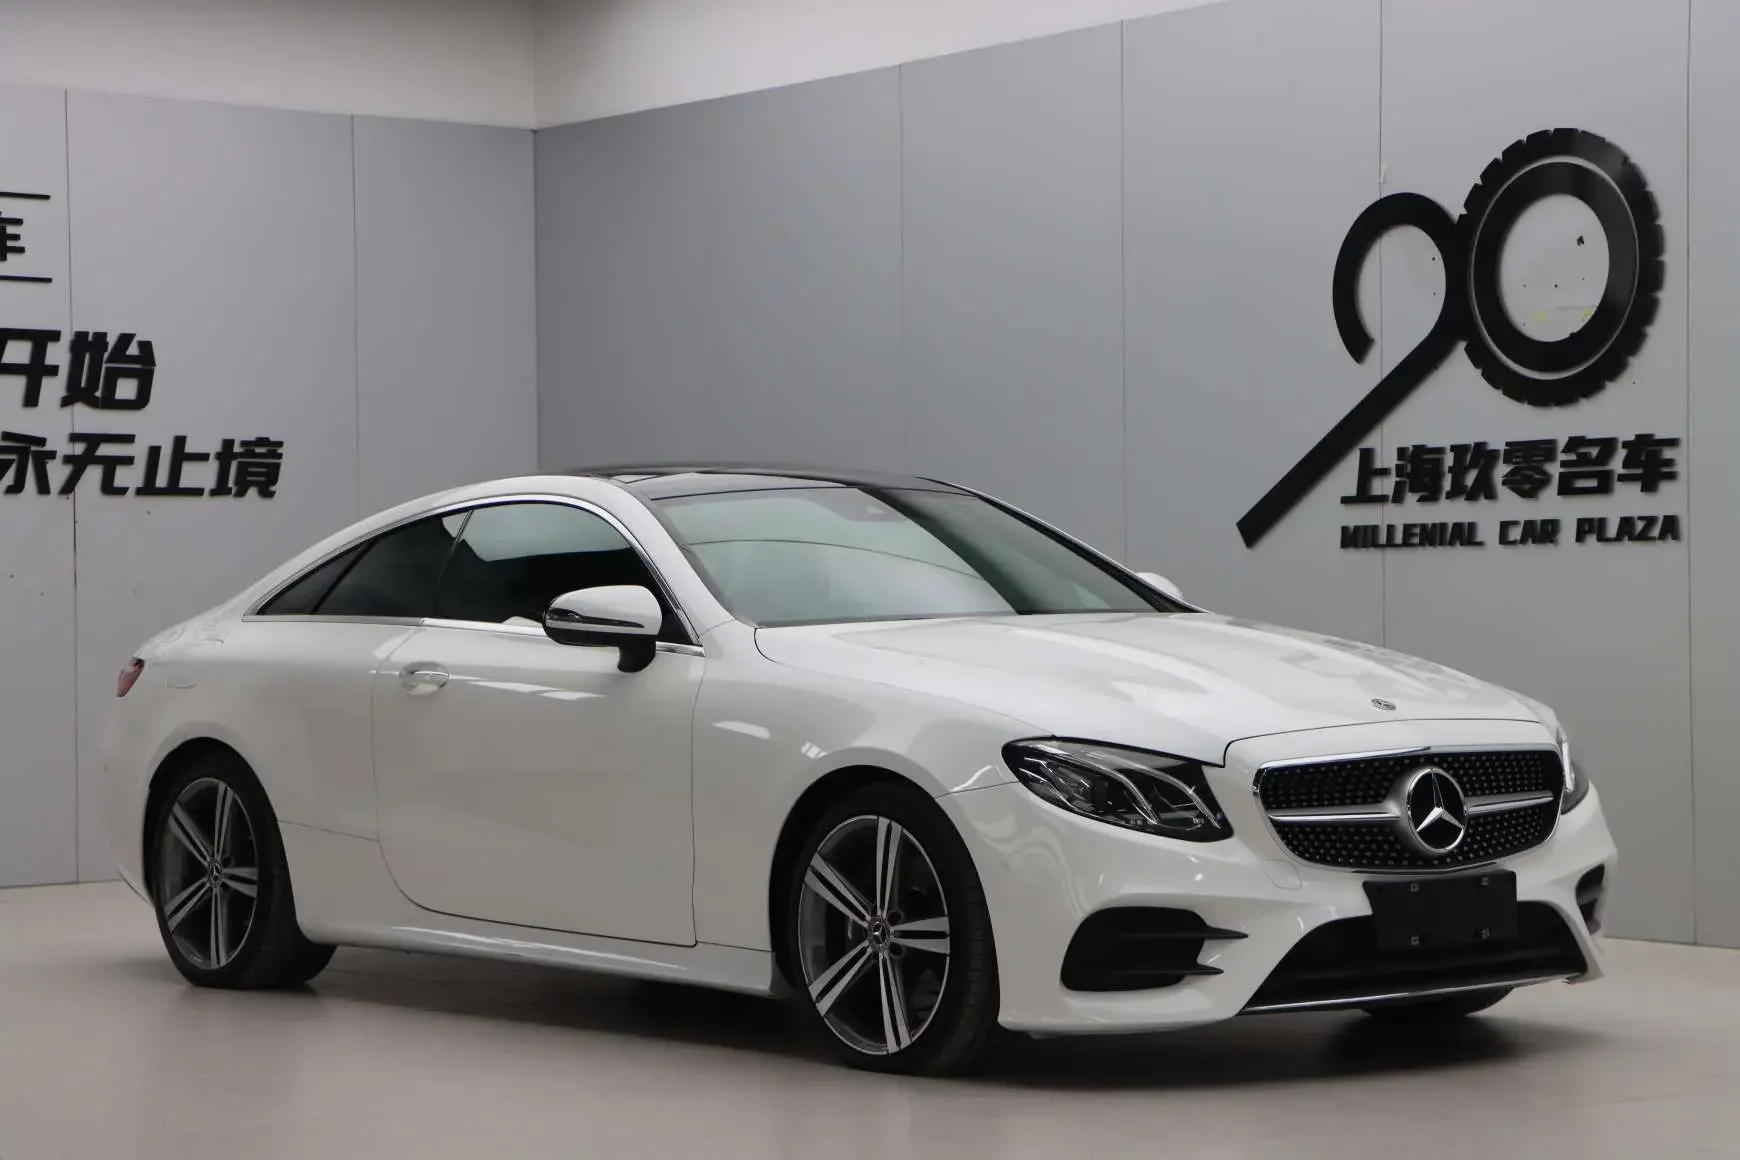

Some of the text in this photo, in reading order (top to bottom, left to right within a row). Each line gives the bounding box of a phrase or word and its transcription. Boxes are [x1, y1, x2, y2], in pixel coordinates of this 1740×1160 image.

[0, 327, 157, 411] 开始
[0, 430, 285, 500] 永无止境
[1339, 433, 1682, 507] 上海玖零名车
[1339, 514, 1682, 552] MILLENIAL CAR PLAZA
